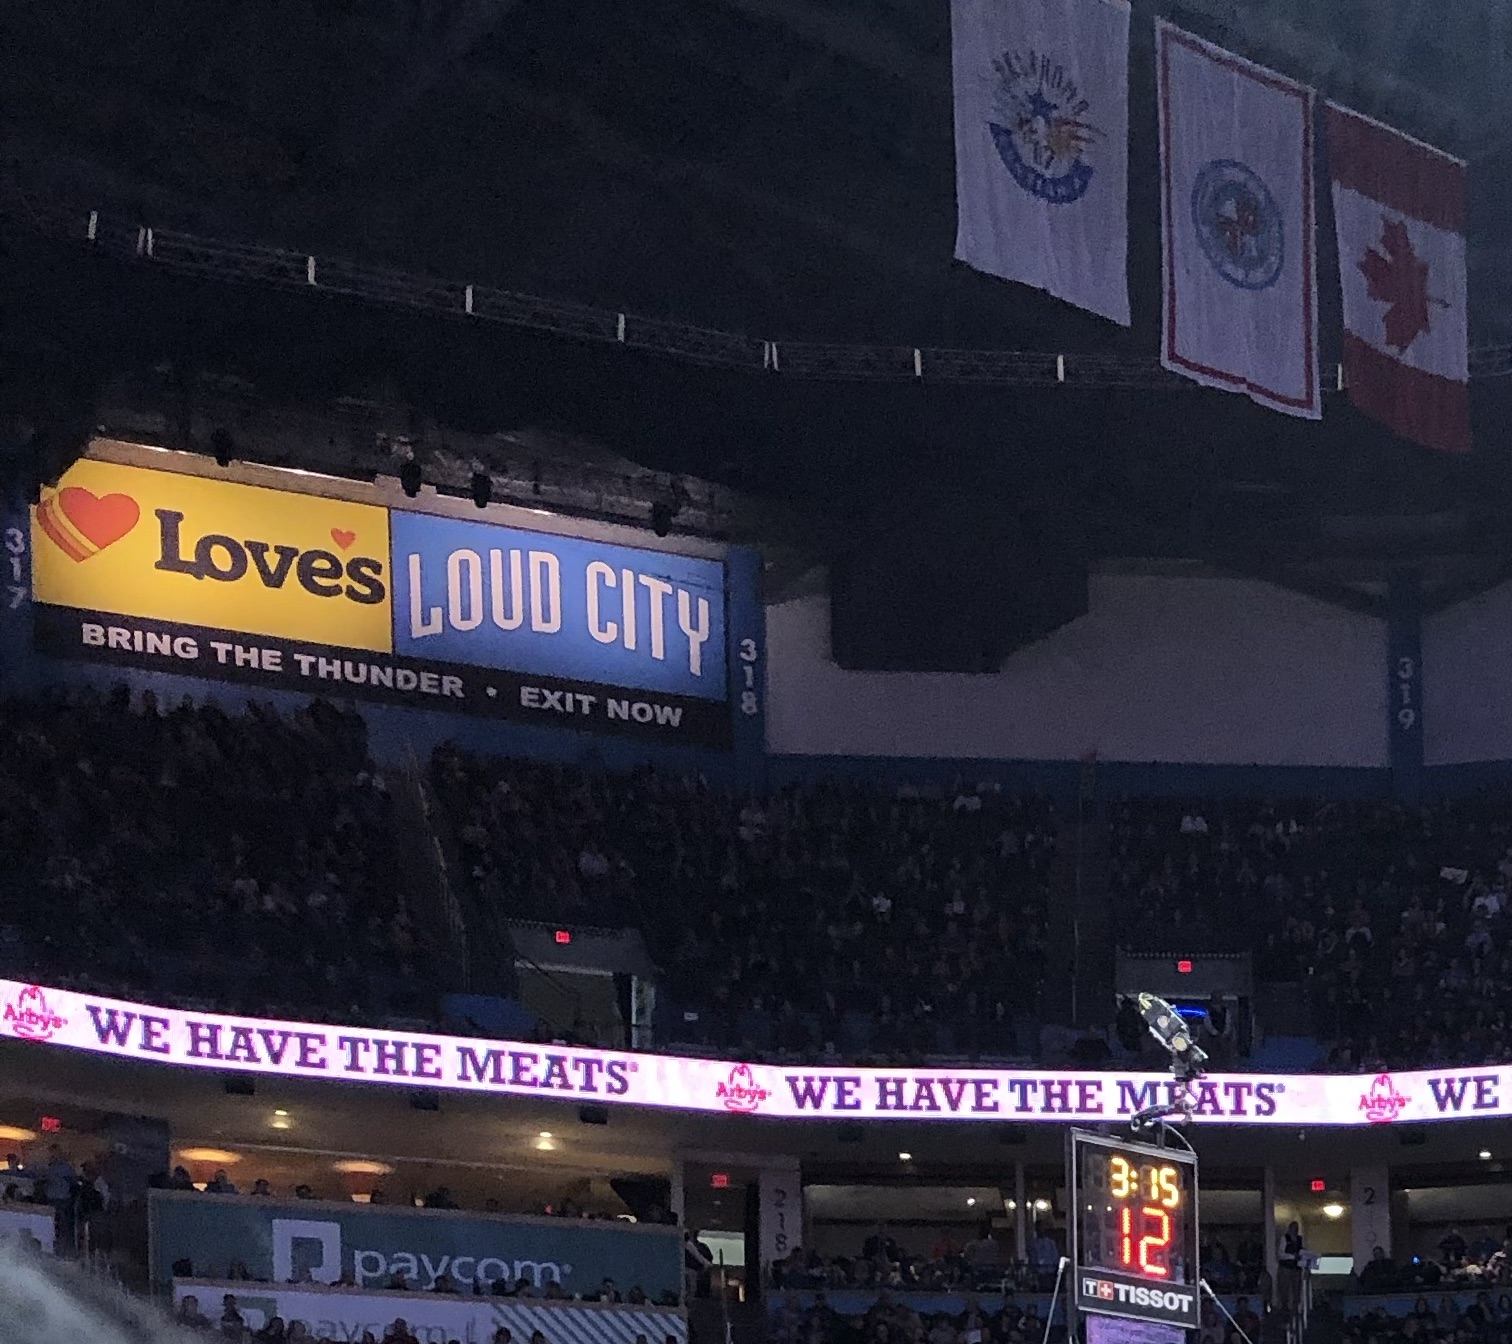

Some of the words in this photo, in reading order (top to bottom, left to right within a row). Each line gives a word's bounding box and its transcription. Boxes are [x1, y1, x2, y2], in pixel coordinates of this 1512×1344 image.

[408, 548, 561, 639] LOUD
[586, 560, 710, 676] CITY
[82, 623, 199, 660] BRING
[210, 641, 283, 673] THE
[293, 652, 465, 699] THUNDER
[520, 686, 597, 716] EXIT
[607, 697, 683, 728] NOW
[739, 638, 758, 715] 318
[85, 1003, 171, 1055] WE
[185, 1020, 328, 1070] HAVE
[338, 1034, 443, 1078] THE
[785, 1074, 861, 1111] WE
[875, 1076, 1001, 1113] HAVE
[1008, 1078, 1102, 1115] THE
[1428, 1074, 1500, 1112] WE
[1110, 1156, 1178, 1208] 3:15
[353, 1246, 562, 1291] paycom
[1119, 1206, 1171, 1277] 12
[1114, 1282, 1194, 1313] TISSOT
